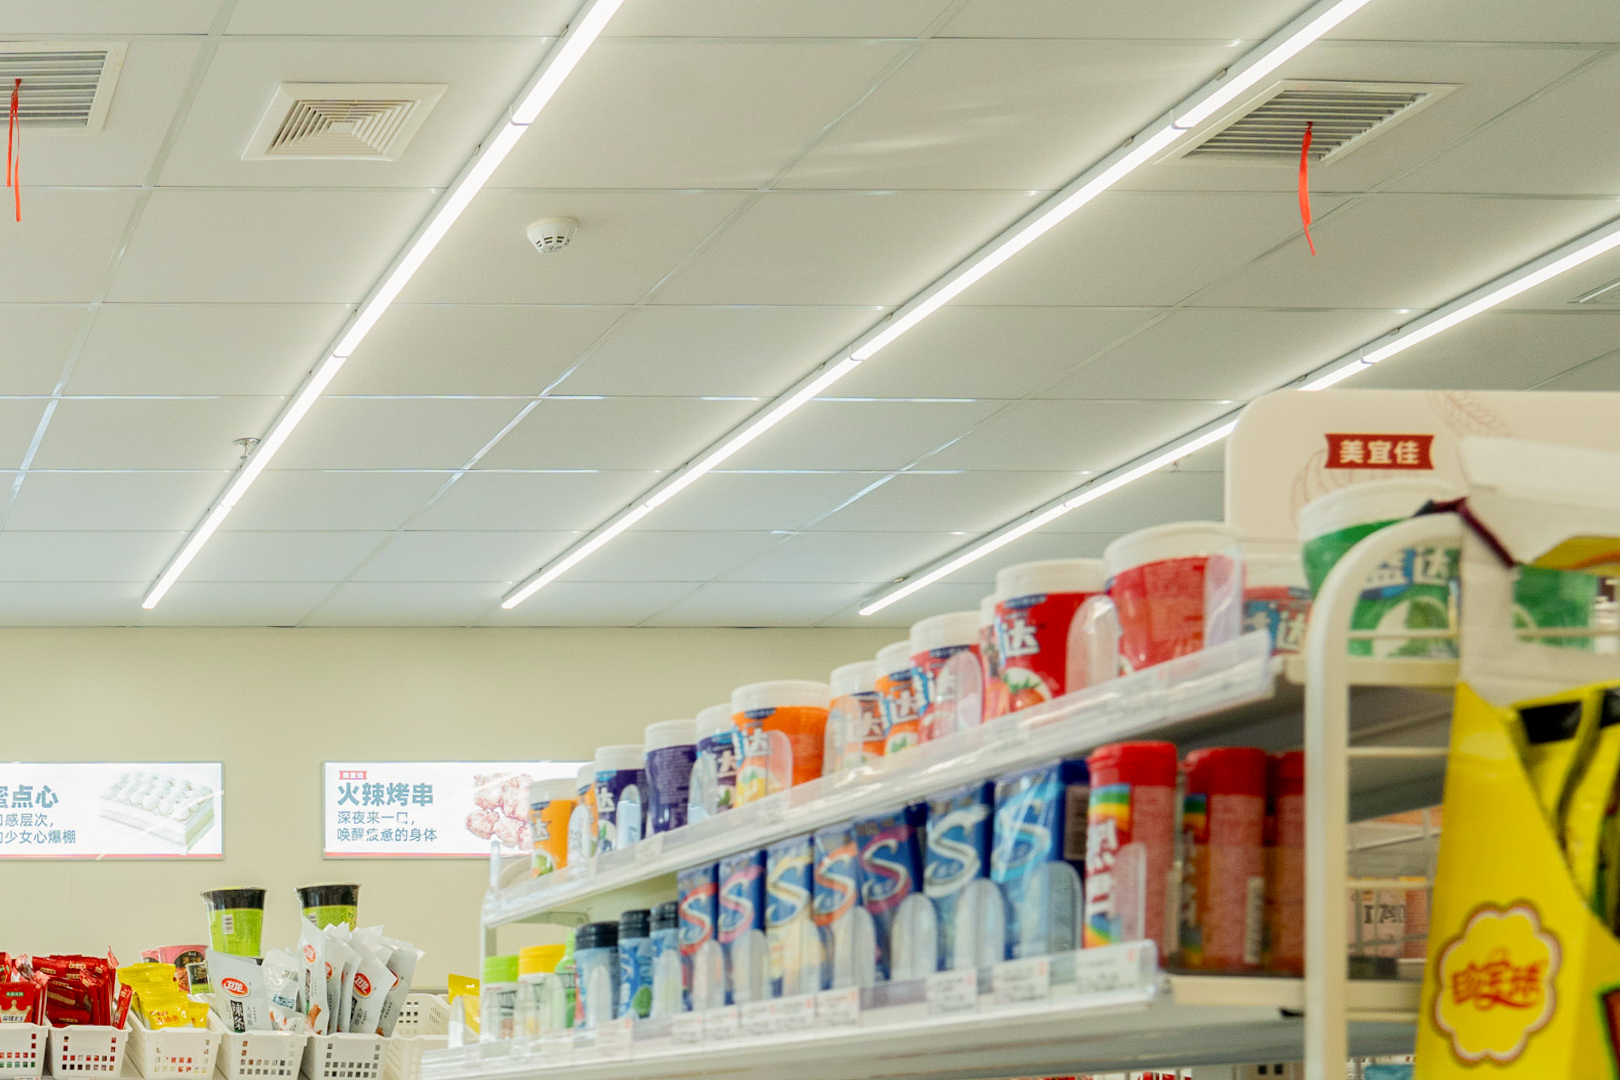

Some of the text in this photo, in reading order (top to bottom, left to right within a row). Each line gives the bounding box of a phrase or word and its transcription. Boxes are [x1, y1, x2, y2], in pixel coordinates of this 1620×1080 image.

[1339, 440, 1420, 465] 美宜佳
[337, 782, 433, 807] 火辣烤串
[337, 827, 437, 842] 唤醒疲惫的身体
[222, 979, 249, 995] 卫龙
